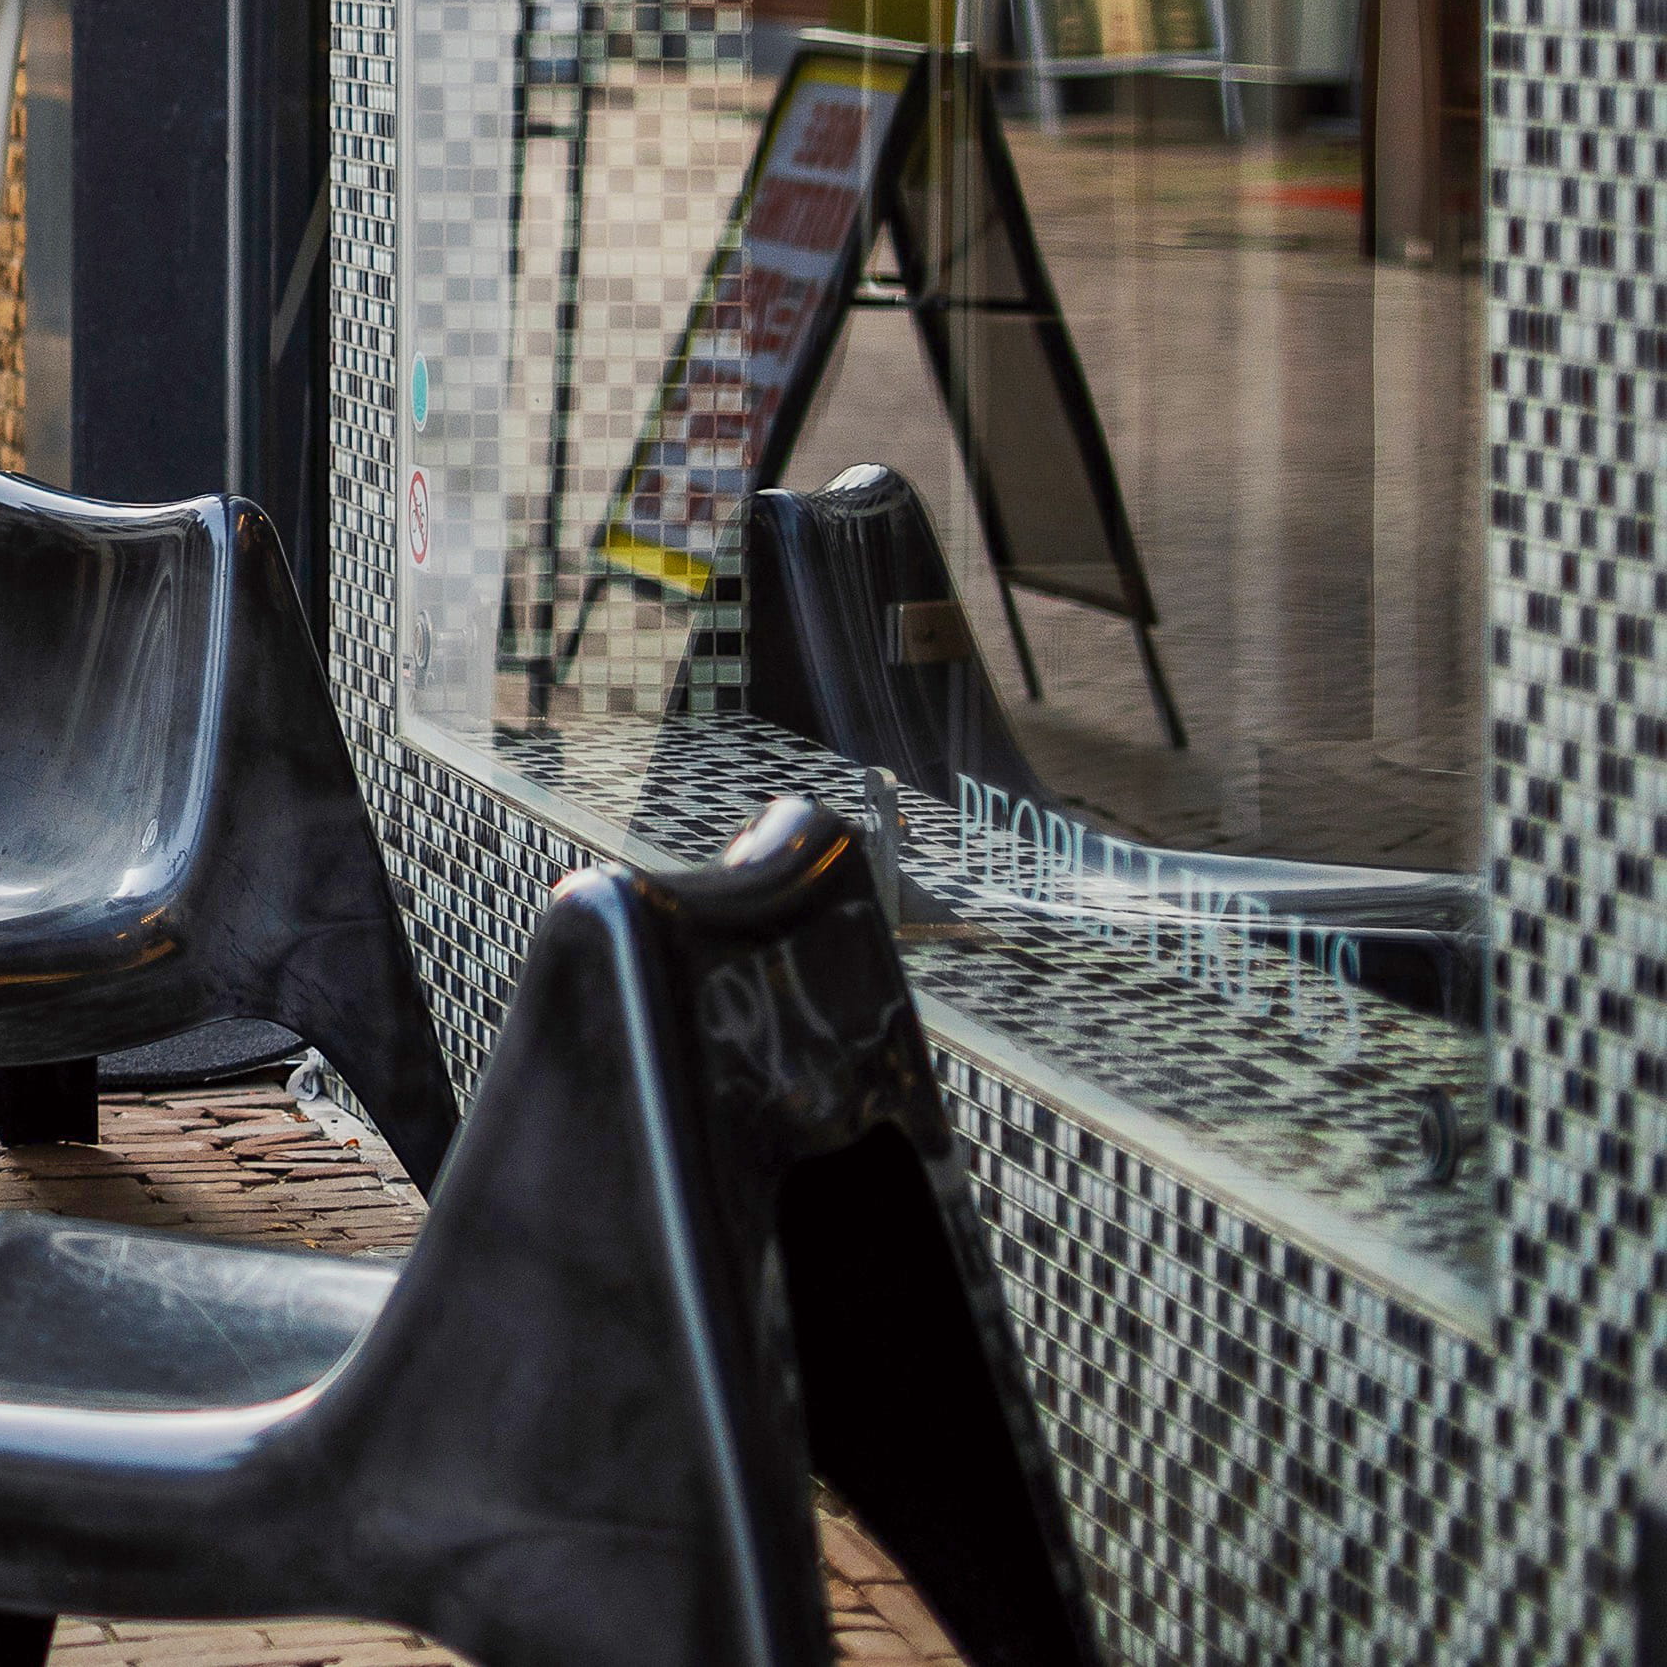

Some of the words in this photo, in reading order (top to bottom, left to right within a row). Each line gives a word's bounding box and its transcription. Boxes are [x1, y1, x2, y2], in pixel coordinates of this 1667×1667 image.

[956, 772, 1132, 947] PEOPLE
[1145, 851, 1272, 1018] LIKE
[1285, 915, 1362, 1065] US
